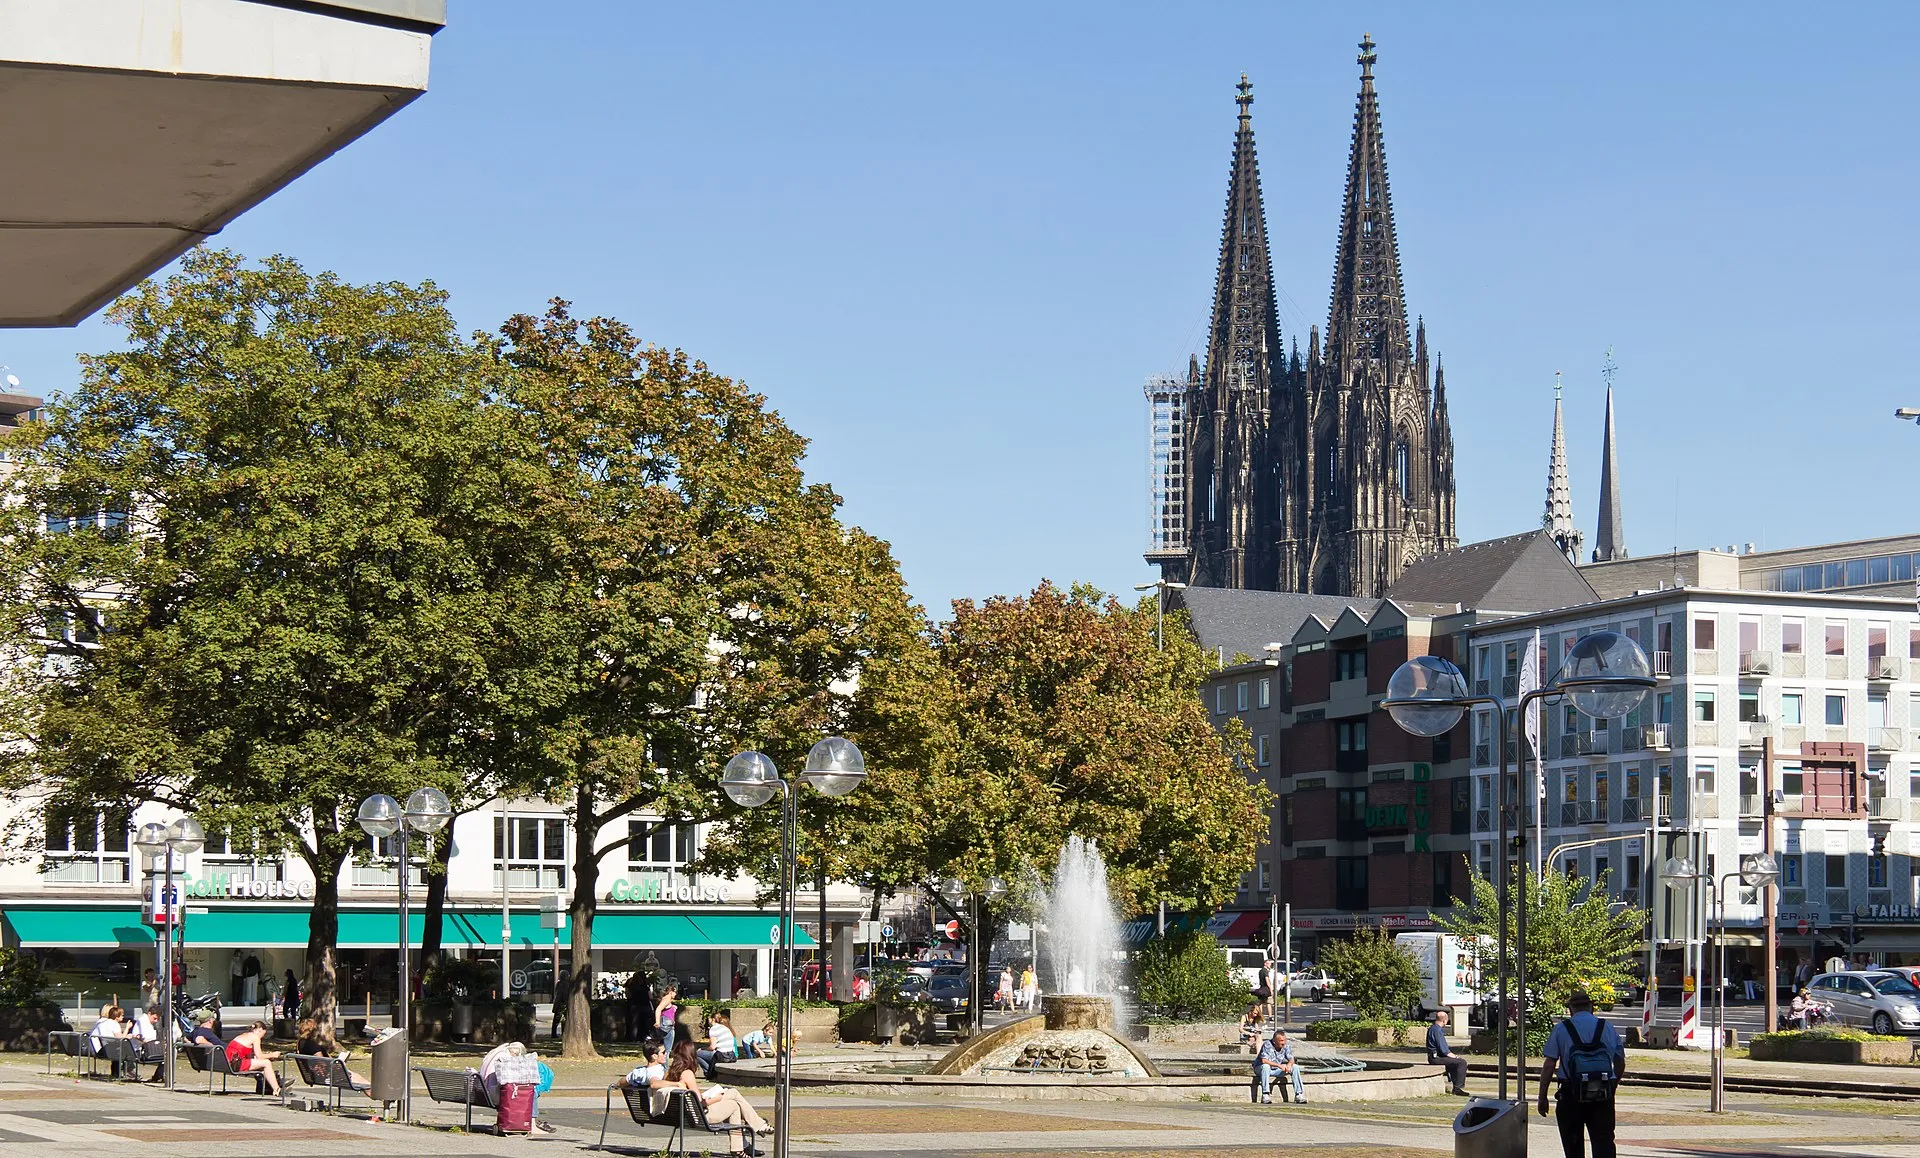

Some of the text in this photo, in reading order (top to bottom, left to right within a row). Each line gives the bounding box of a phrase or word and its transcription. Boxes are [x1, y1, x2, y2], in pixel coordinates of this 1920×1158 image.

[1365, 804, 1408, 828] DEVK
[1413, 763, 1431, 853] DEVK
[1382, 916, 1406, 926] Miele
[1409, 919, 1434, 927] Miele
